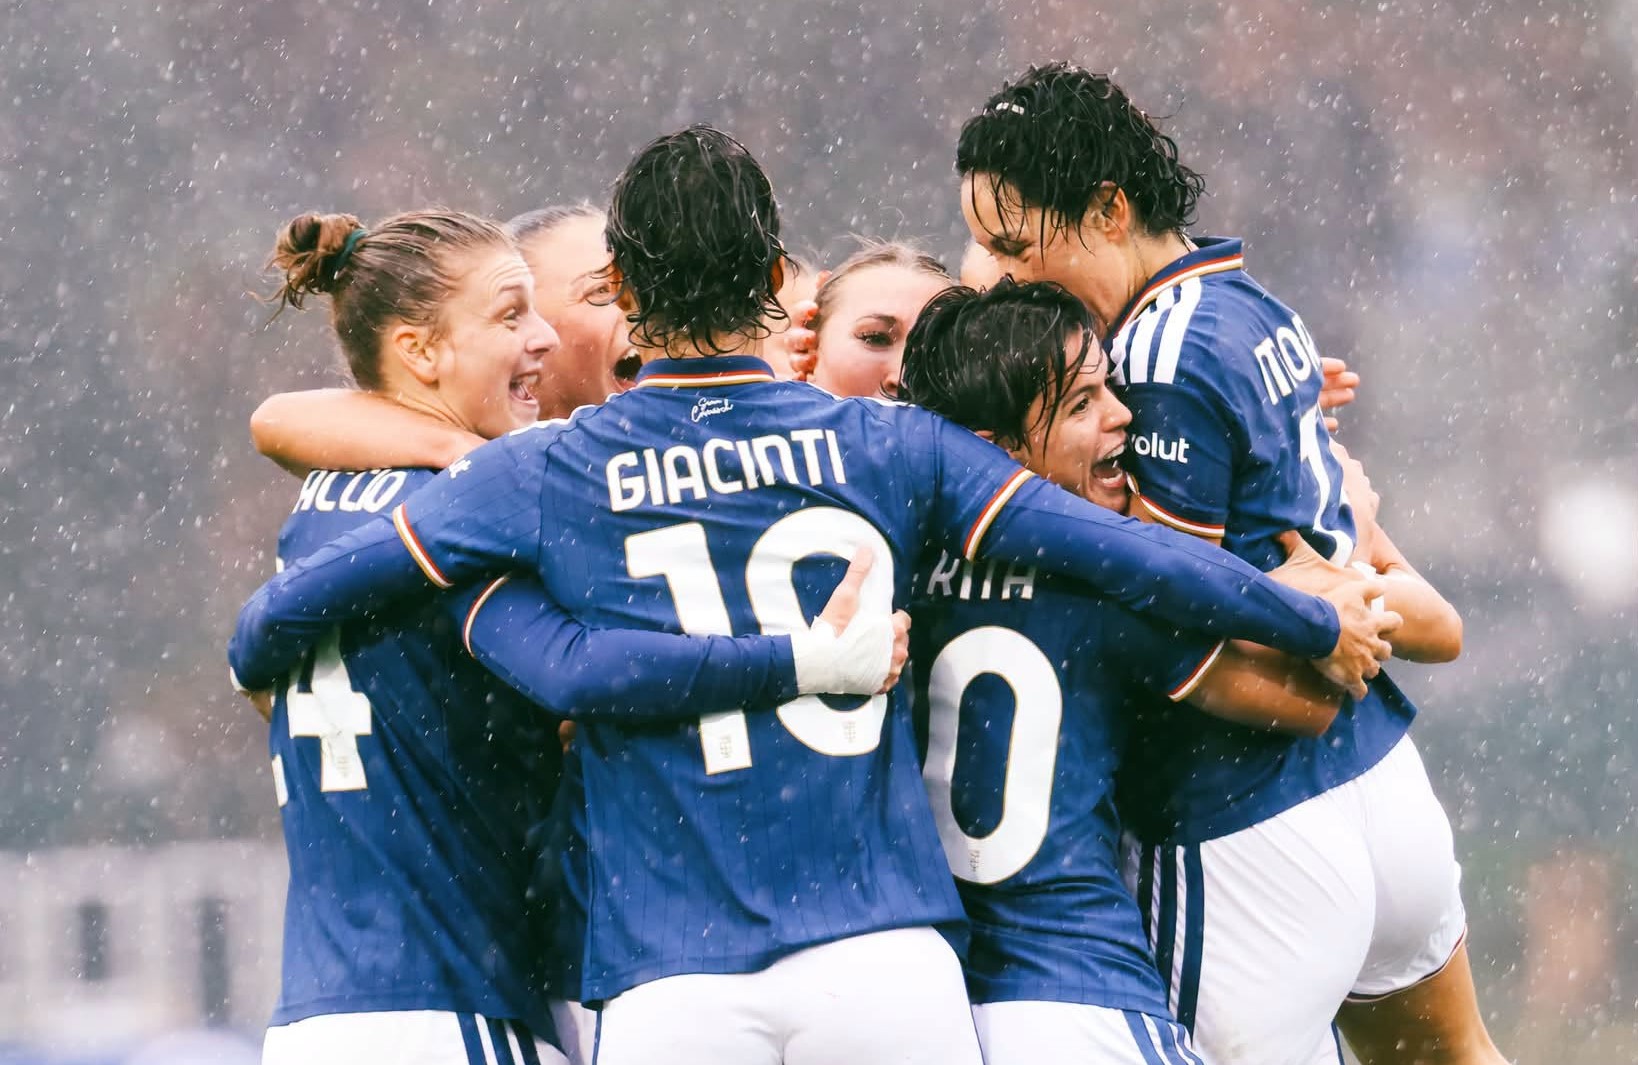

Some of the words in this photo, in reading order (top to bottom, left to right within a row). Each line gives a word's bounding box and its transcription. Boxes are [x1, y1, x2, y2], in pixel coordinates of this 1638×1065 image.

[606, 429, 847, 512] GIACINTI
[271, 618, 373, 800] 4
[921, 625, 1064, 885] 0
